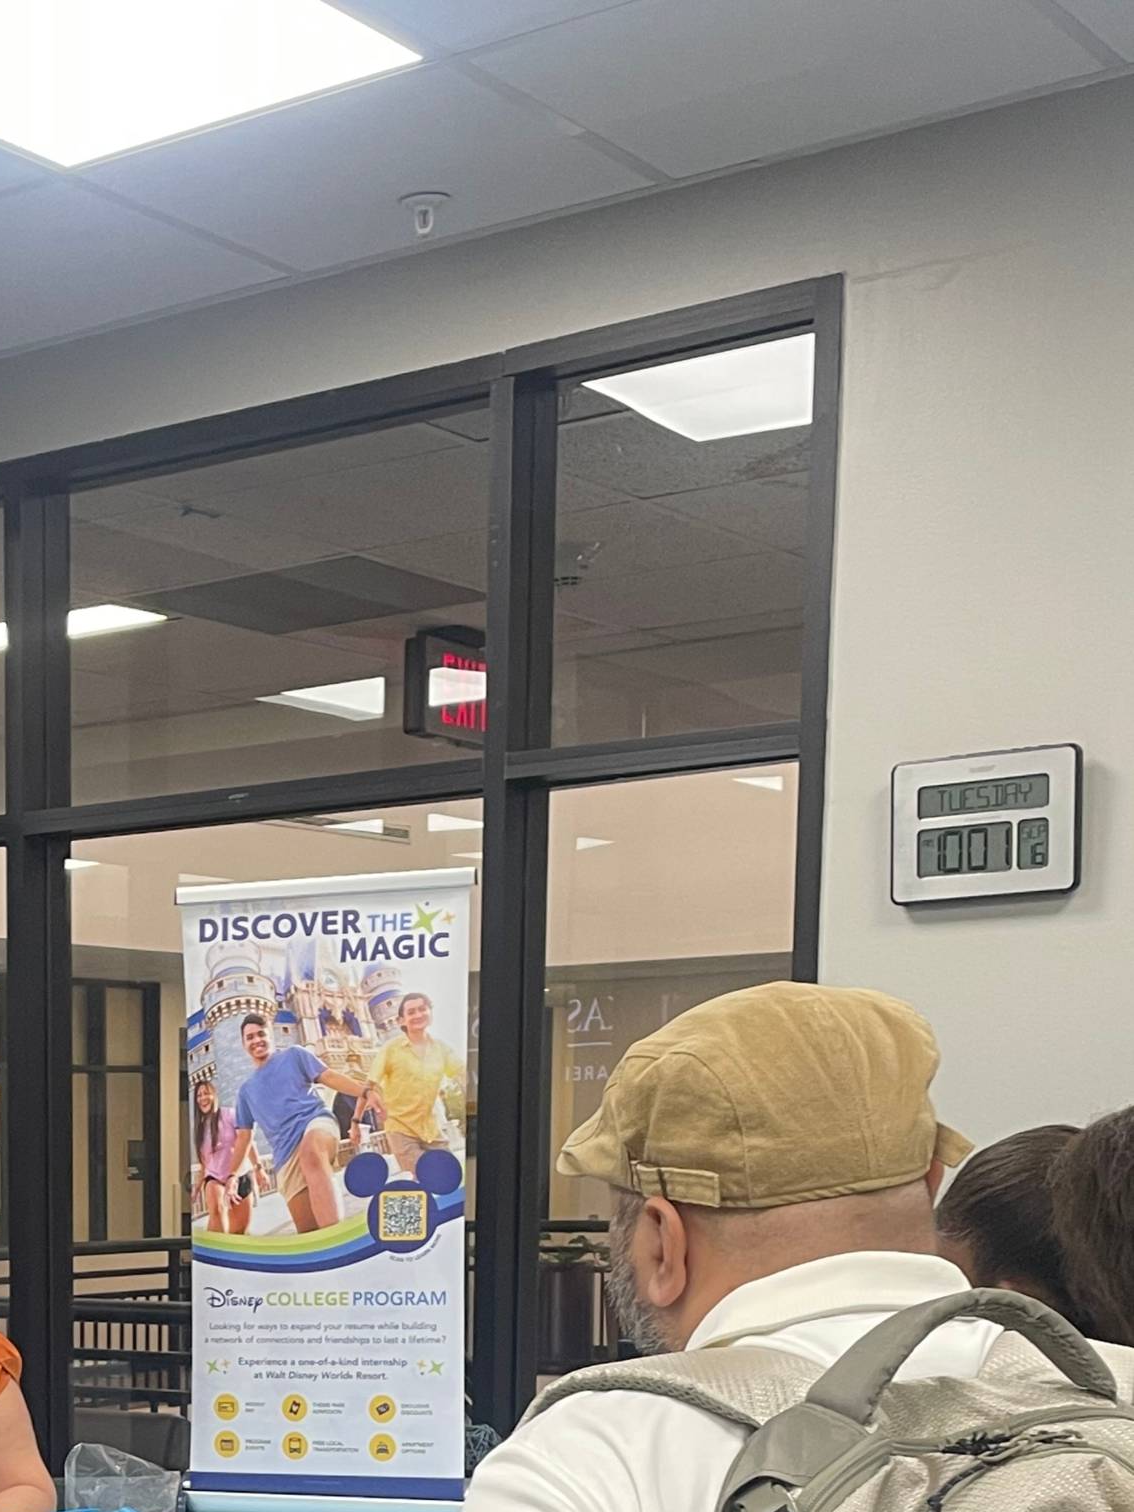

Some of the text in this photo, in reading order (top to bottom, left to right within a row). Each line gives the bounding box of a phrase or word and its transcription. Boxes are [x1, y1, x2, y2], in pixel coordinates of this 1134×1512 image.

[937, 782, 1033, 812] TUESDAY
[198, 909, 412, 943] DISCOVER THE
[340, 932, 450, 963] MAGIC
[266, 1291, 350, 1307] COLLEGE
[353, 1290, 447, 1307] PROGRAM
[209, 1321, 437, 1332] Looking for ways to expand your resume while building
[210, 1335, 243, 1344] network
[246, 1335, 254, 1344] of
[256, 1336, 305, 1344] connections
[307, 1336, 323, 1344] and
[324, 1335, 370, 1346] friendships
[372, 1336, 382, 1344] to
[384, 1335, 399, 1344] last
[408, 1335, 447, 1344] lifetime?
[238, 1356, 287, 1367] Experience
[298, 1357, 359, 1367] one-of-a-kind
[361, 1357, 408, 1368] internship
[254, 1371, 263, 1379] at
[266, 1370, 286, 1379] Walt
[288, 1371, 318, 1381] Disney
